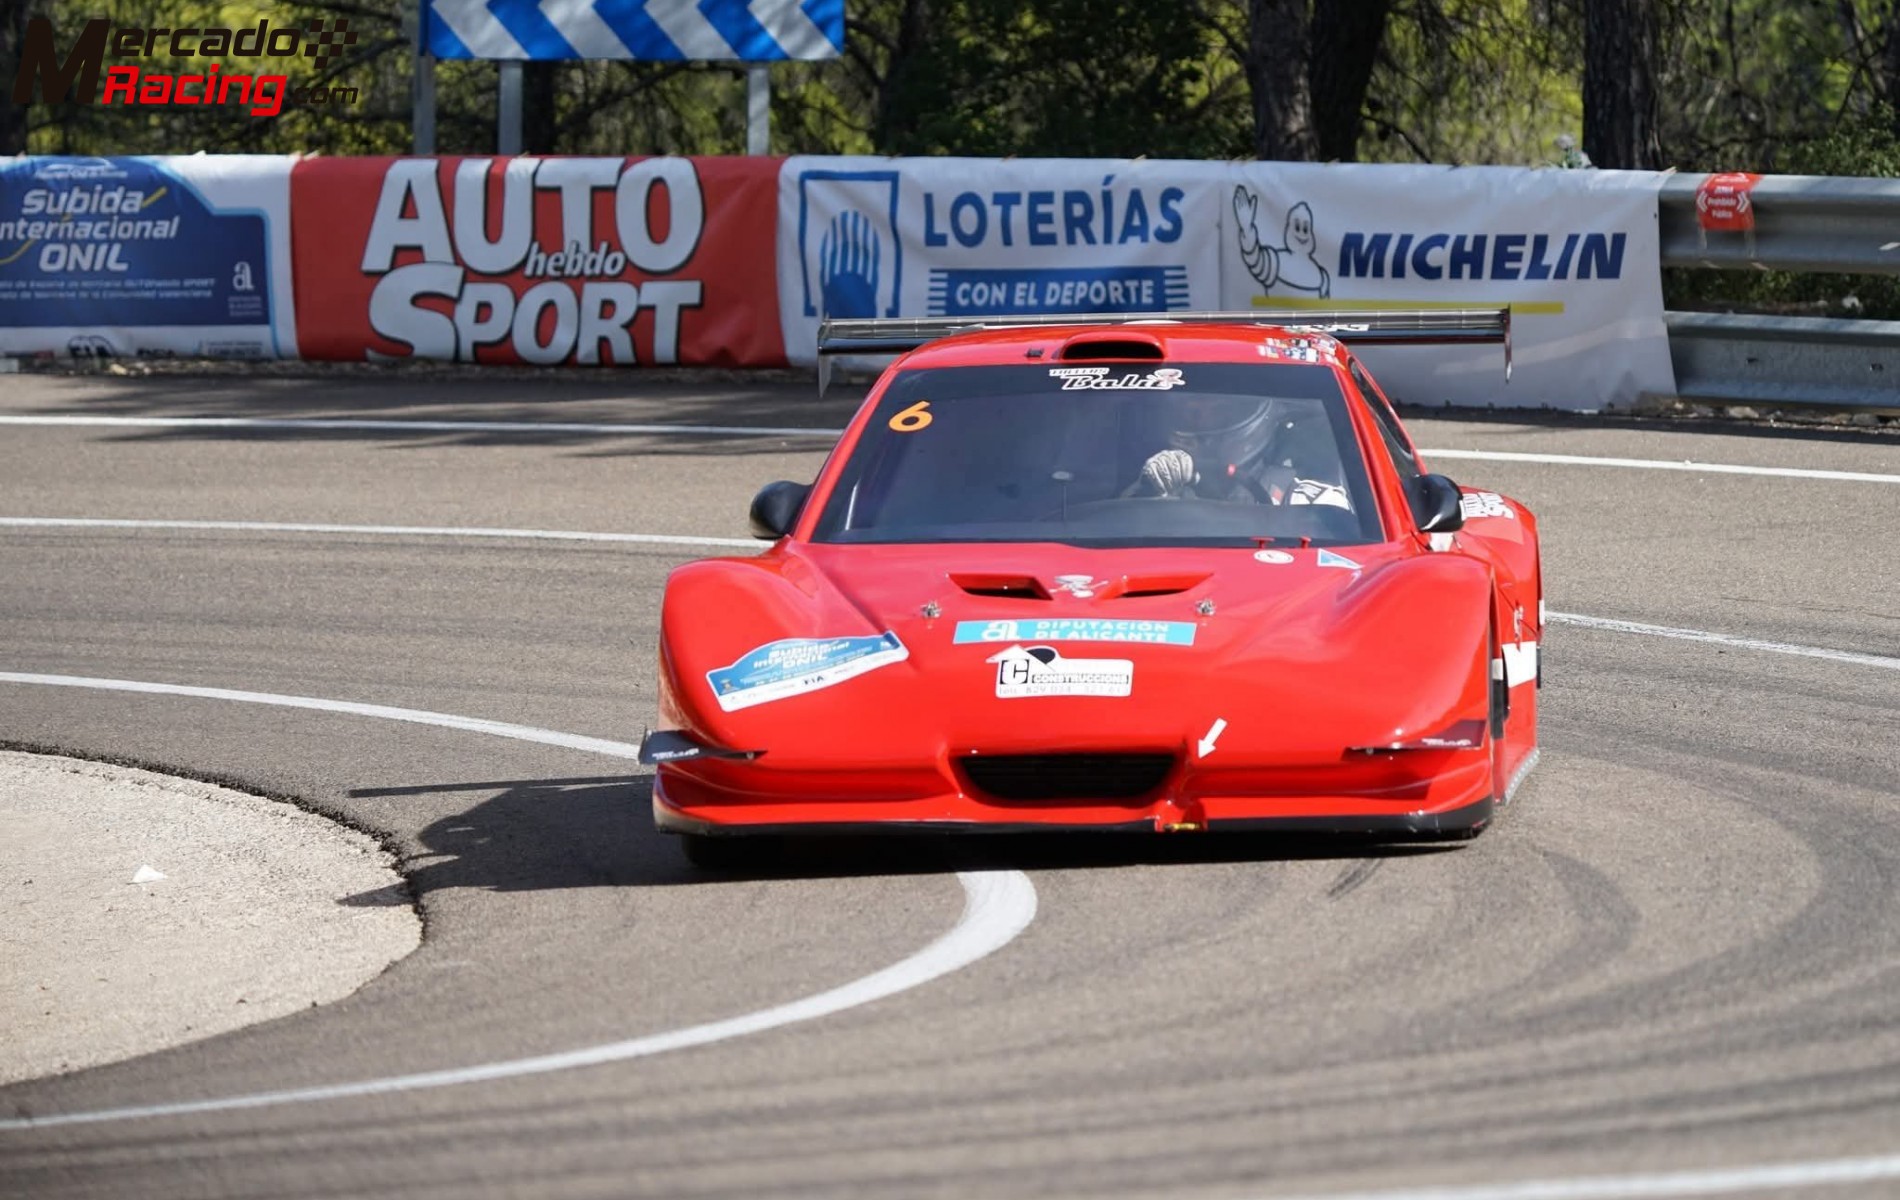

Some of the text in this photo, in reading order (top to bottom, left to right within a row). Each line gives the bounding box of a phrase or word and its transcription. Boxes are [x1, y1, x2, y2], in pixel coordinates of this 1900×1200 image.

[21, 184, 144, 214] Subida
[361, 159, 705, 274] AUTO
[923, 174, 1186, 248] LOTERÍAS
[38, 243, 129, 272] ONIL
[523, 240, 628, 279] hebdo
[1337, 231, 1628, 281] MICHELIN
[955, 279, 1154, 307] CON EL DEPORTE
[365, 262, 704, 366] SPORT
[888, 400, 933, 433] 6
[1035, 631, 1167, 643] DE ALICANTE
